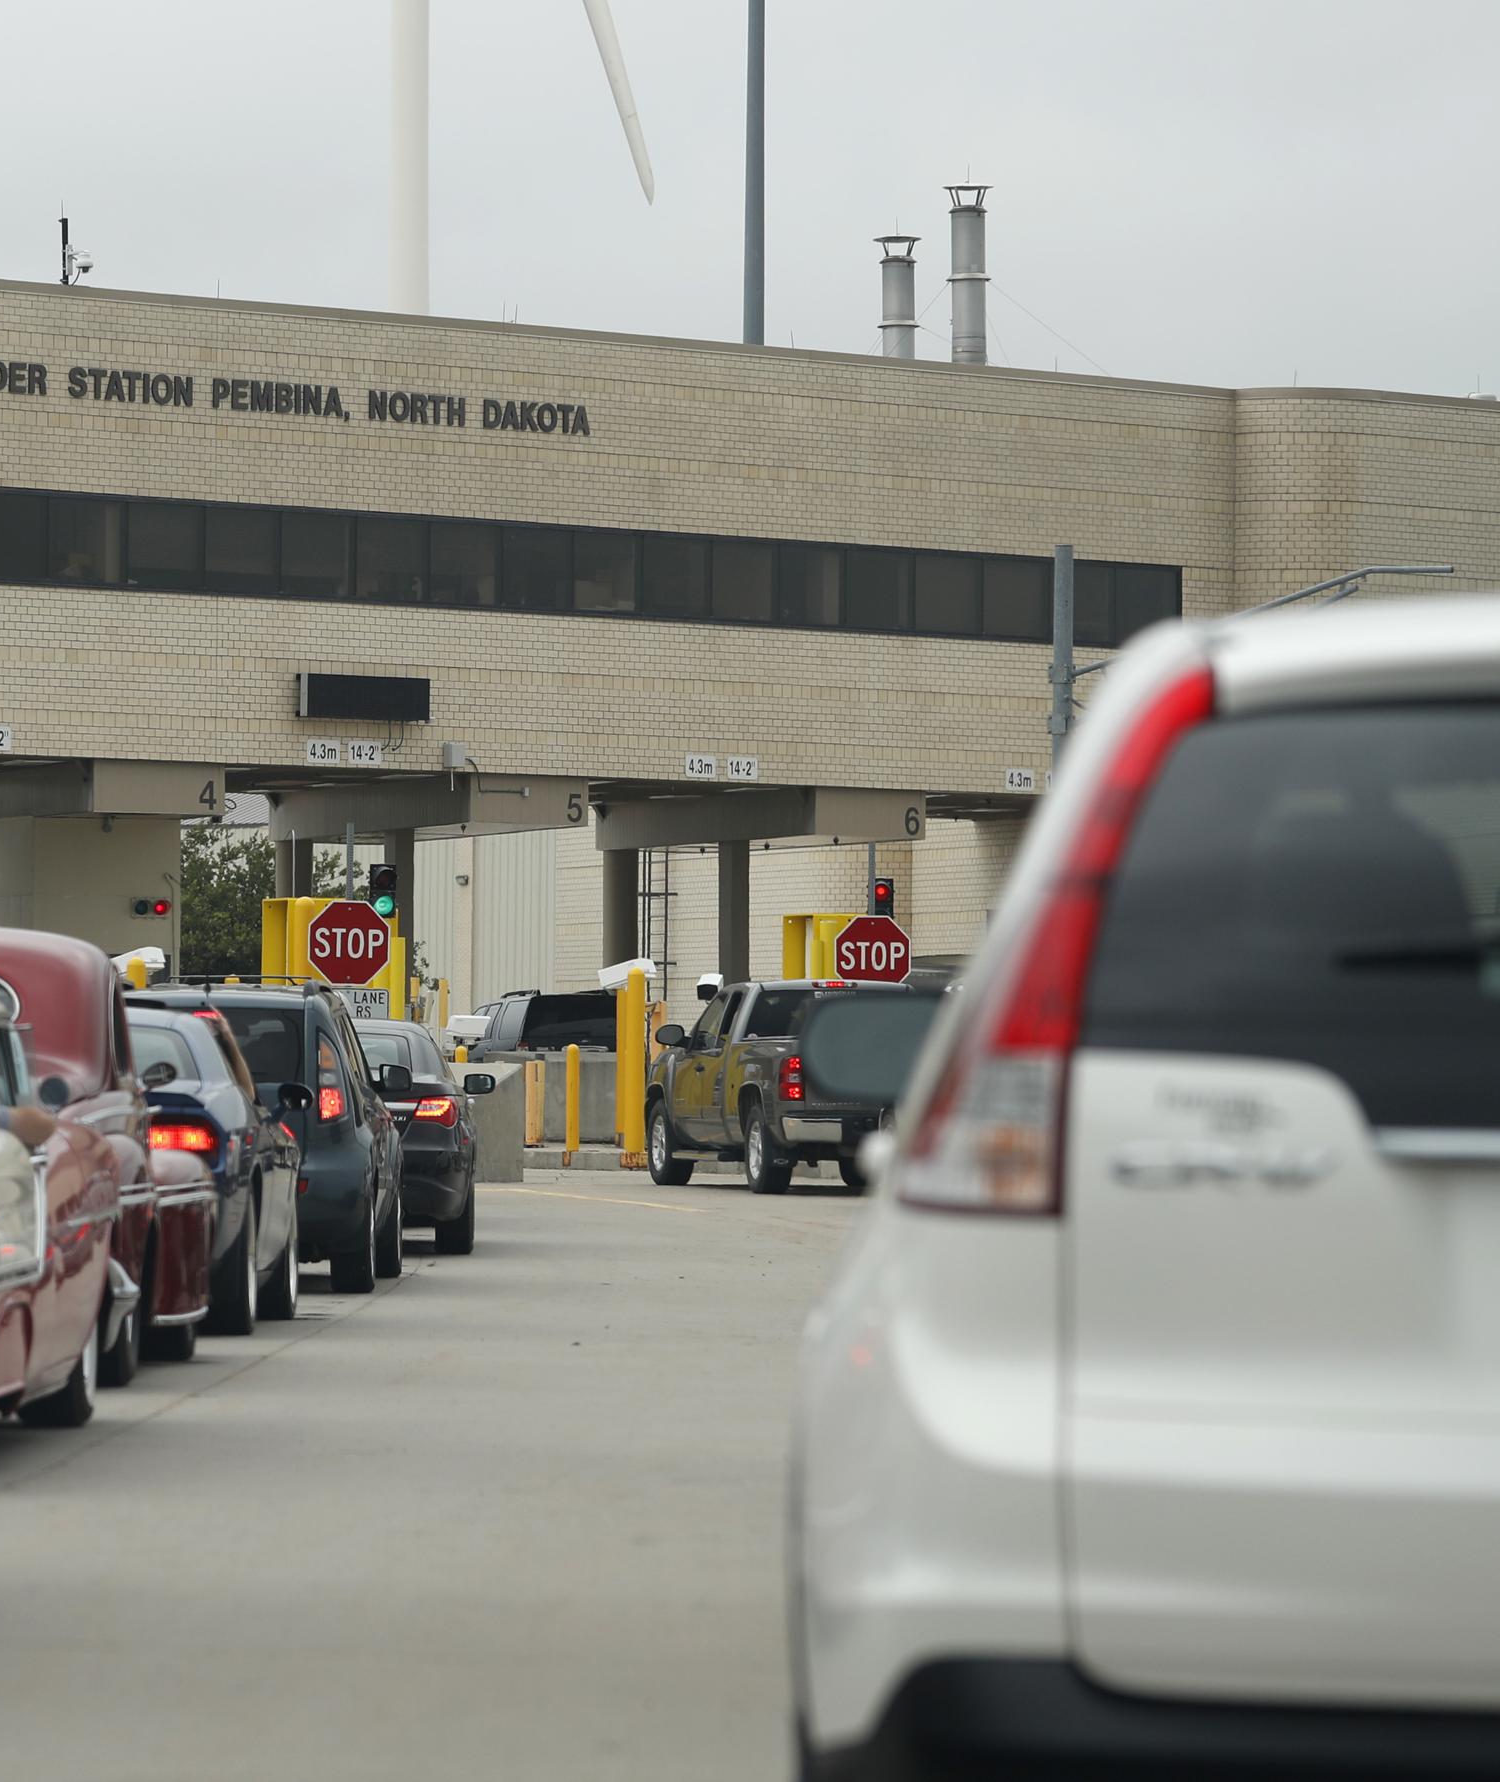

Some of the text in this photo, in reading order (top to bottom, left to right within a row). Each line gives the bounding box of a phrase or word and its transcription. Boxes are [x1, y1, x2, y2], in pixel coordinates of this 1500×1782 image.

[67, 366, 194, 408] STATION
[211, 377, 351, 423] PEMBINA,
[367, 389, 467, 429] NORTH
[482, 398, 591, 438] DAKOTA
[309, 742, 338, 762] 4.3m
[687, 758, 714, 776] 4.3m
[198, 779, 218, 811] 4
[1007, 771, 1033, 789] 4.3m
[565, 793, 584, 824] 5
[902, 805, 921, 837] 6
[314, 927, 384, 959] STOP
[840, 941, 905, 971] STOP
[353, 991, 386, 1004] LANE
